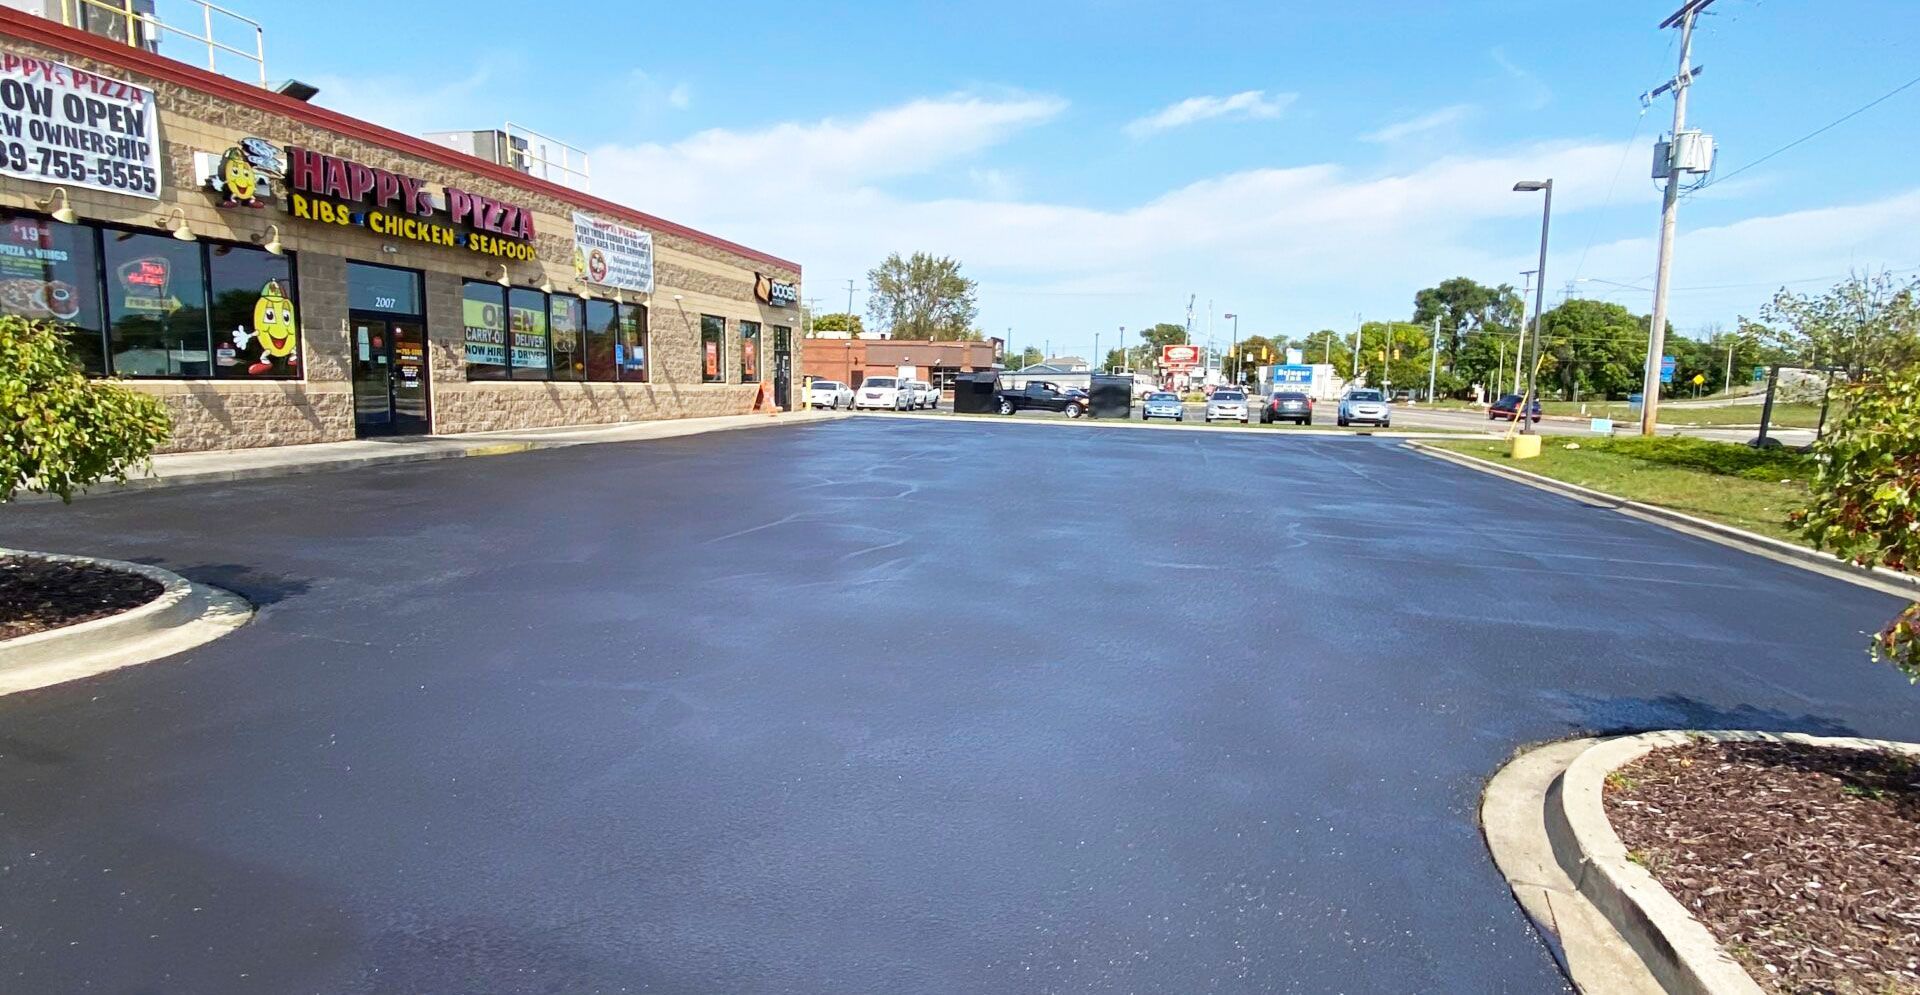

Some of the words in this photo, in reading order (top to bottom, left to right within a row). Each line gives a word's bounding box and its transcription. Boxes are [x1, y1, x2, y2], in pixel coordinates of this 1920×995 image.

[63, 93, 144, 137] OPEN
[29, 119, 150, 161] OWNERSHIP
[446, 187, 536, 240] PIZZA
[292, 193, 349, 225] RIBS
[368, 211, 453, 247] CHICKEN
[468, 233, 536, 262] SEAFOOD
[596, 239, 609, 250] BACK
[606, 233, 623, 244] SUNDAY
[35, 248, 68, 261] WINGS
[375, 297, 395, 308] 2007
[466, 327, 504, 344] CARRY-OU
[515, 333, 545, 348] DELIVER
[465, 344, 485, 356] NOW
[487, 347, 515, 358] HIRIG
